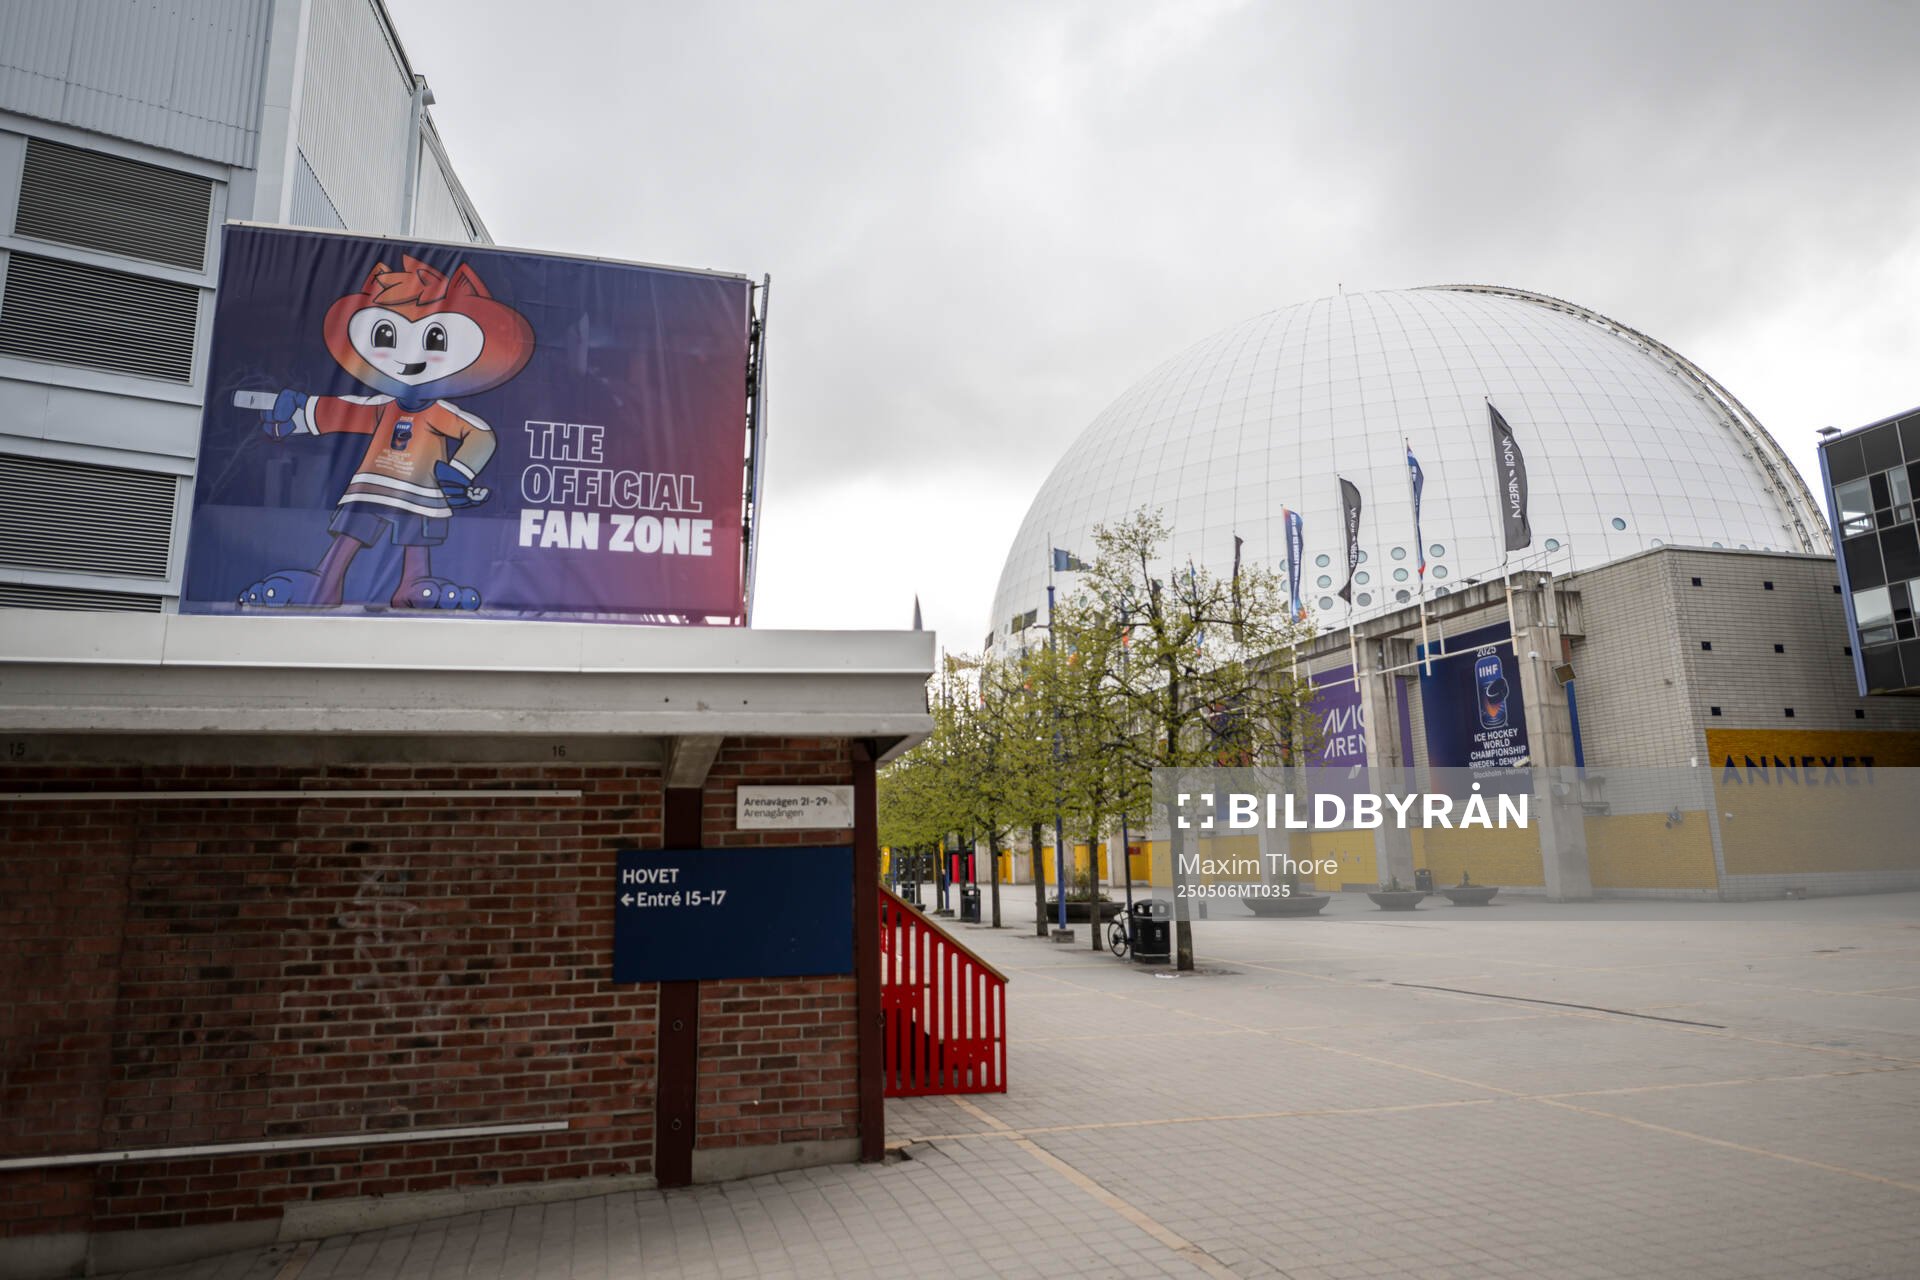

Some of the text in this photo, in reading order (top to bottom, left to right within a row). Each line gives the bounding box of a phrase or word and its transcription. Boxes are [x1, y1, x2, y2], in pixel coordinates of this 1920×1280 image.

[524, 420, 604, 463] THE
[521, 464, 702, 512] OFFICIAL
[519, 508, 713, 556] FAN ZONE
[1478, 663, 1499, 678] IIHF
[1474, 728, 1518, 743] ICE HOCKEY
[552, 744, 567, 758] 16
[1482, 738, 1510, 750] WORLD
[1470, 745, 1527, 760] CHAMPIONSHIP
[1722, 754, 1876, 786] ANNEXET
[622, 868, 679, 884] HOVET
[637, 889, 727, 908] Entré 15-17
